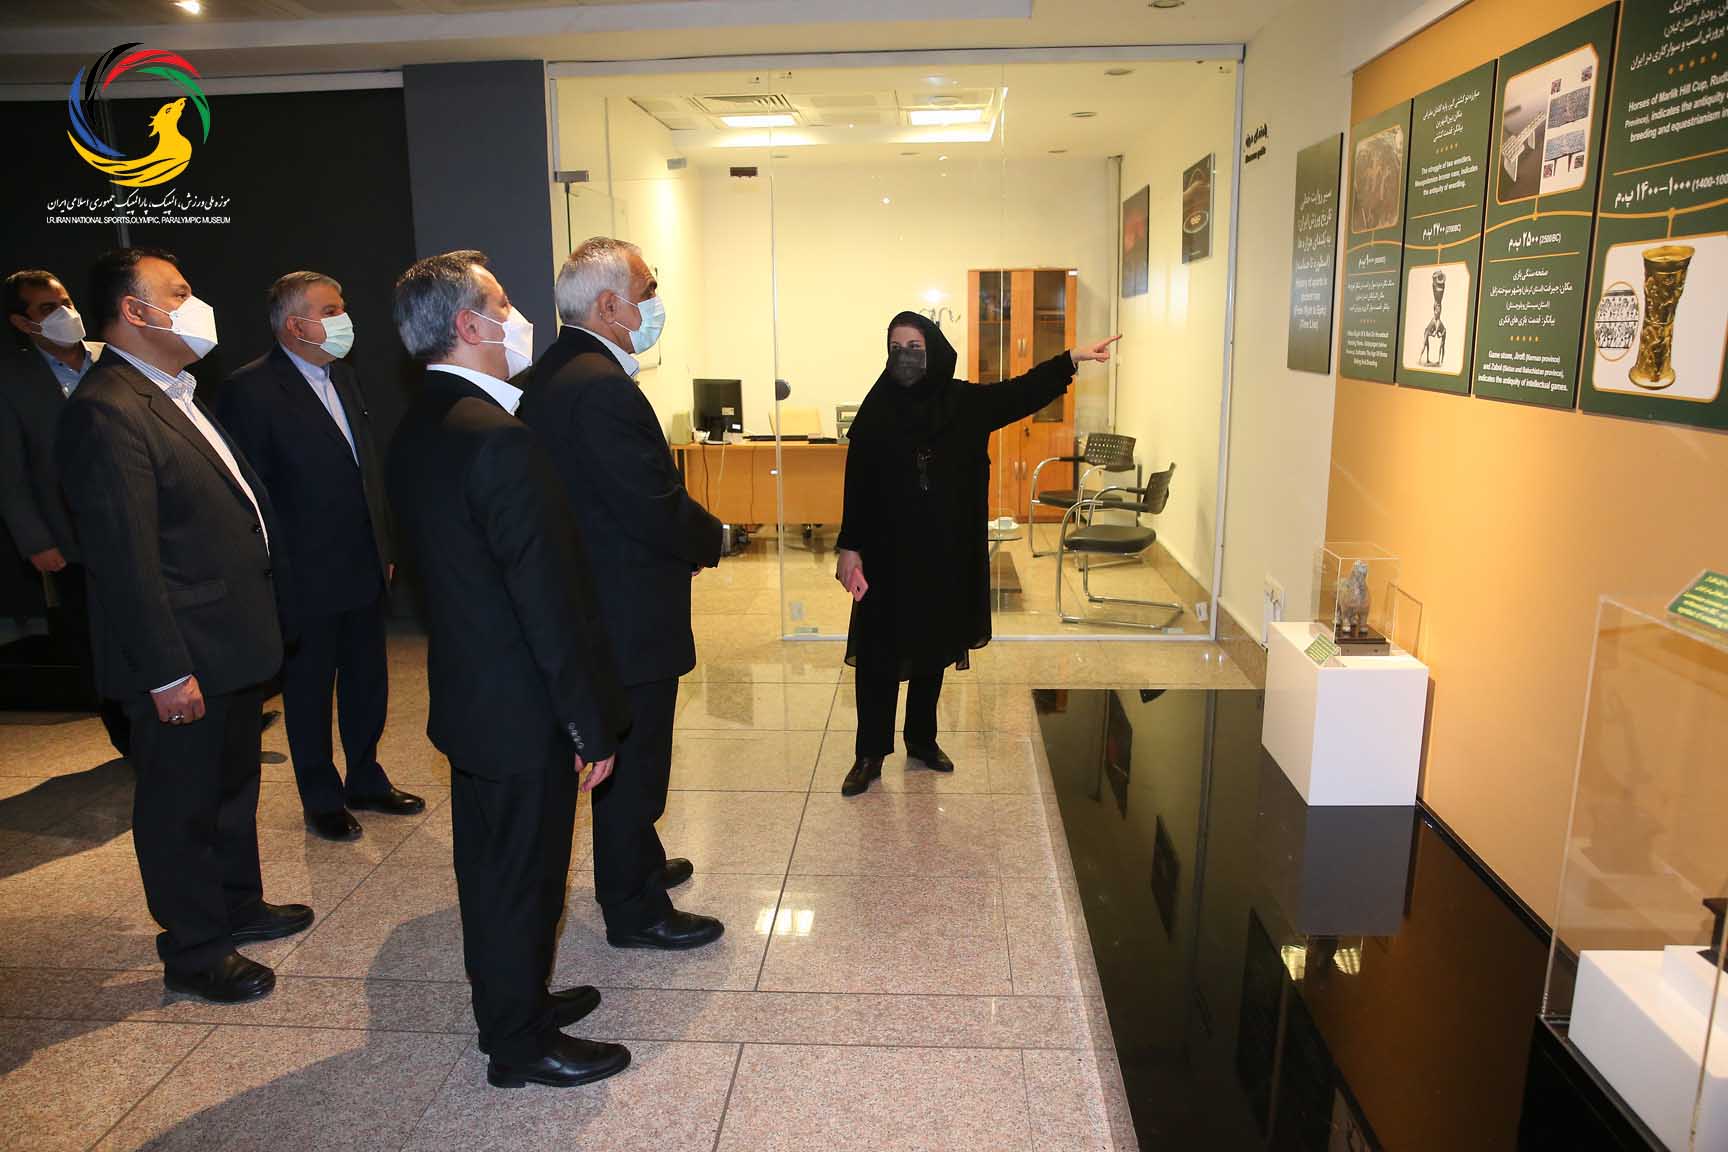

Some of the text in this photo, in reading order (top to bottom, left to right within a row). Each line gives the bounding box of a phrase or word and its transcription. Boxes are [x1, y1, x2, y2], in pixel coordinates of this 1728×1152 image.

[1628, 99, 1650, 112] Horses
[1651, 94, 1658, 105] of
[1680, 83, 1692, 96] Hill
[1682, 101, 1692, 112] the
[1630, 128, 1657, 142] breeding
[1658, 122, 1671, 135] and
[1488, 350, 1500, 359] Game
